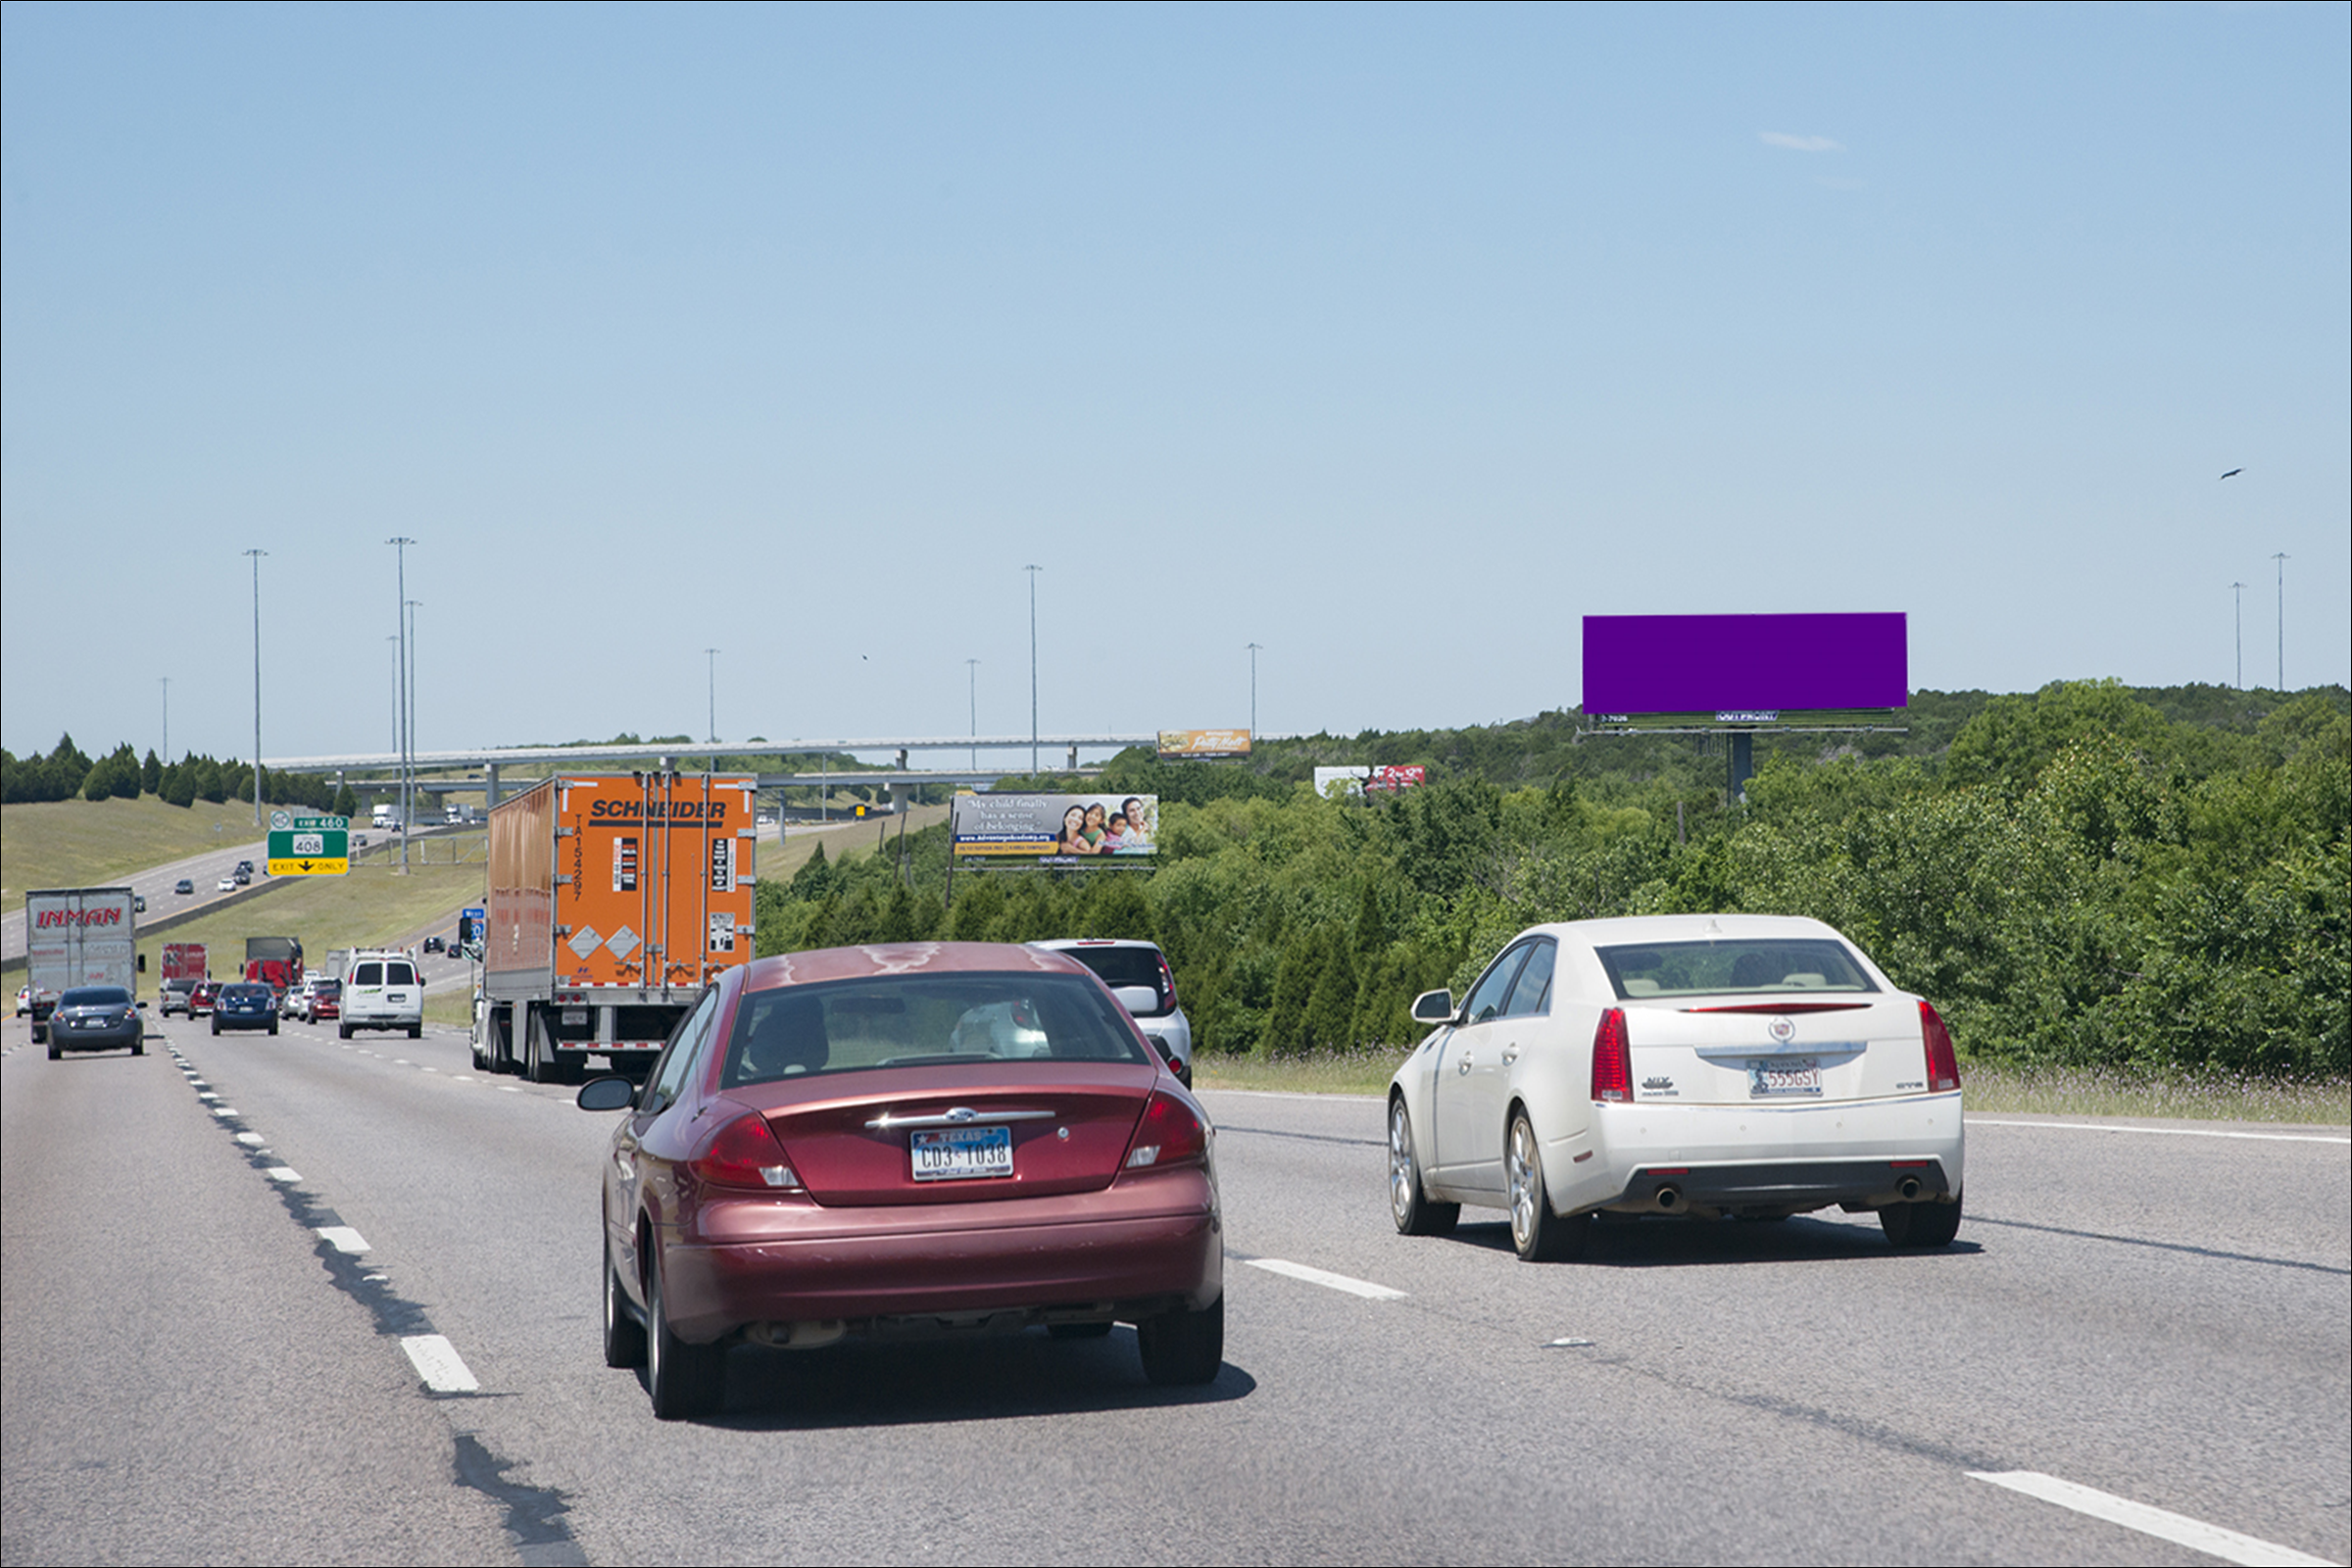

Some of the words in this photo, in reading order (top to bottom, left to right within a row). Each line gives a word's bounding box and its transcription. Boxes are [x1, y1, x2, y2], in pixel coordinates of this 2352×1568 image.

[590, 799, 727, 819] SCHNEIDER
[989, 797, 1015, 808] child
[1016, 797, 1049, 809] finally
[980, 811, 999, 820] has
[319, 817, 344, 829] 460
[973, 821, 984, 831] of
[295, 841, 321, 853] 408
[272, 862, 294, 871] EXIT
[35, 906, 122, 928] INMAN
[1768, 1068, 1820, 1087] 555GSY
[940, 1131, 982, 1143] TEXAS
[920, 1146, 954, 1169] CD3
